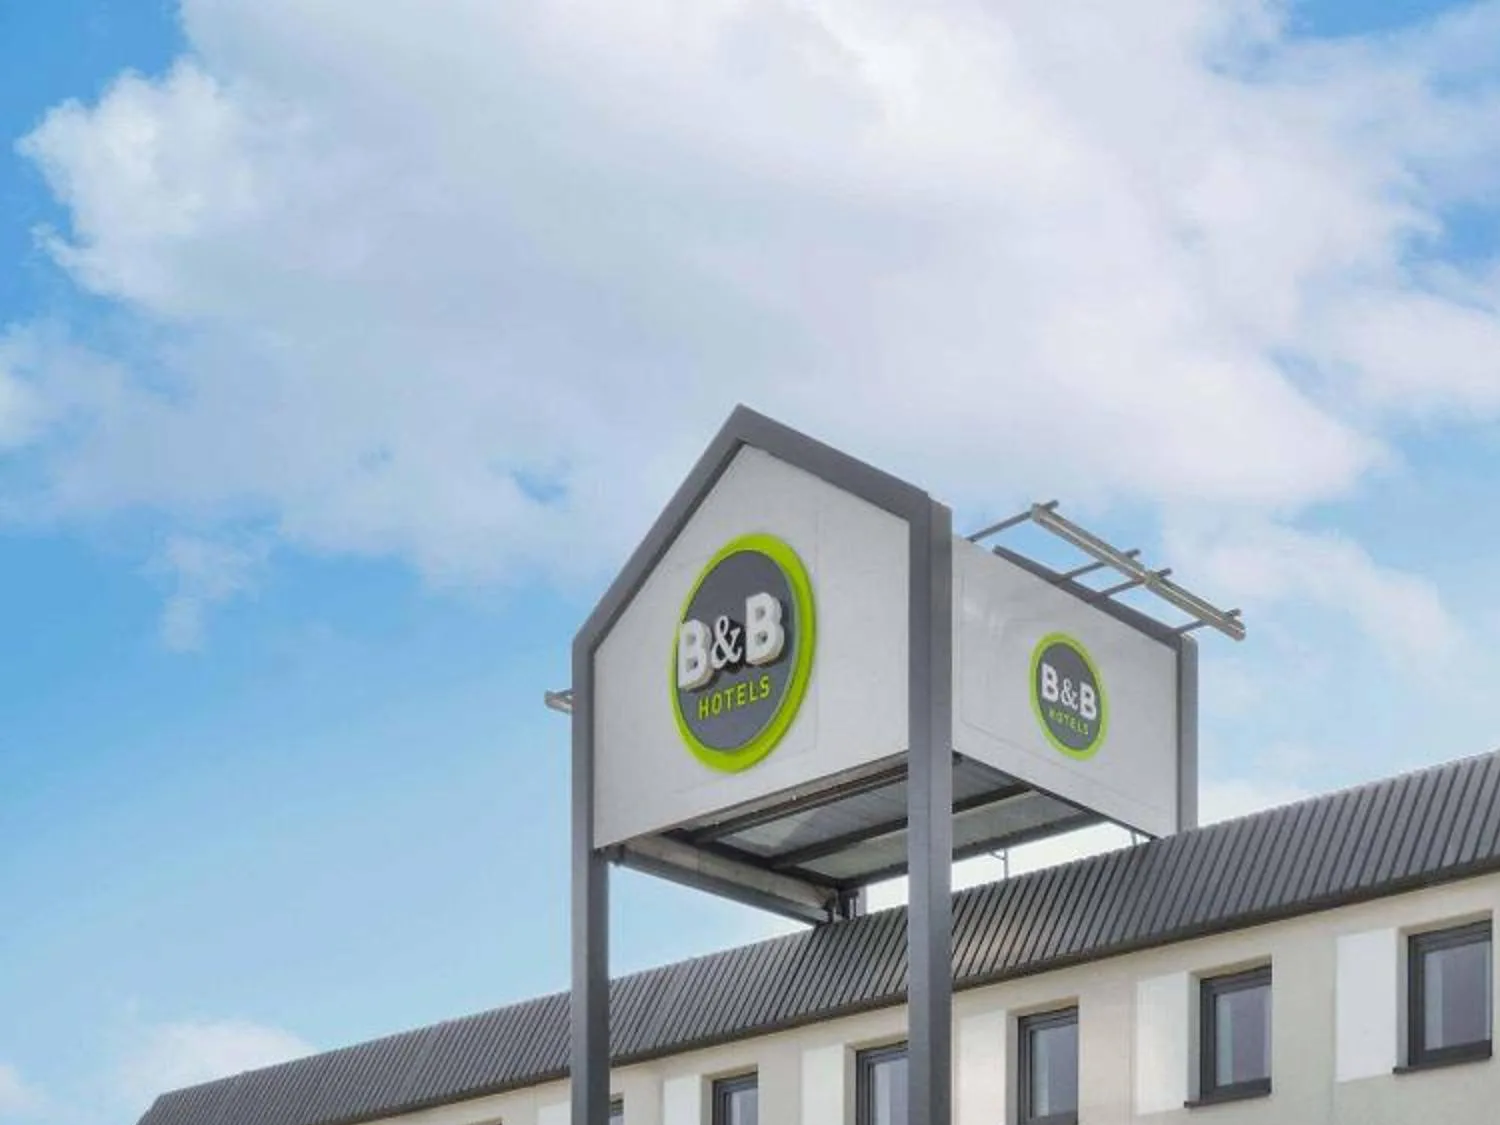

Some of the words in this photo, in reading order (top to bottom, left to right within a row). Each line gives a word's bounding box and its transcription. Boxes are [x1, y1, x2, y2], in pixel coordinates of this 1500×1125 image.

[678, 592, 785, 691] B&B
[699, 675, 770, 721] HOTELS
[1041, 662, 1097, 721] B&B
[1049, 707, 1089, 735] HOTELS
